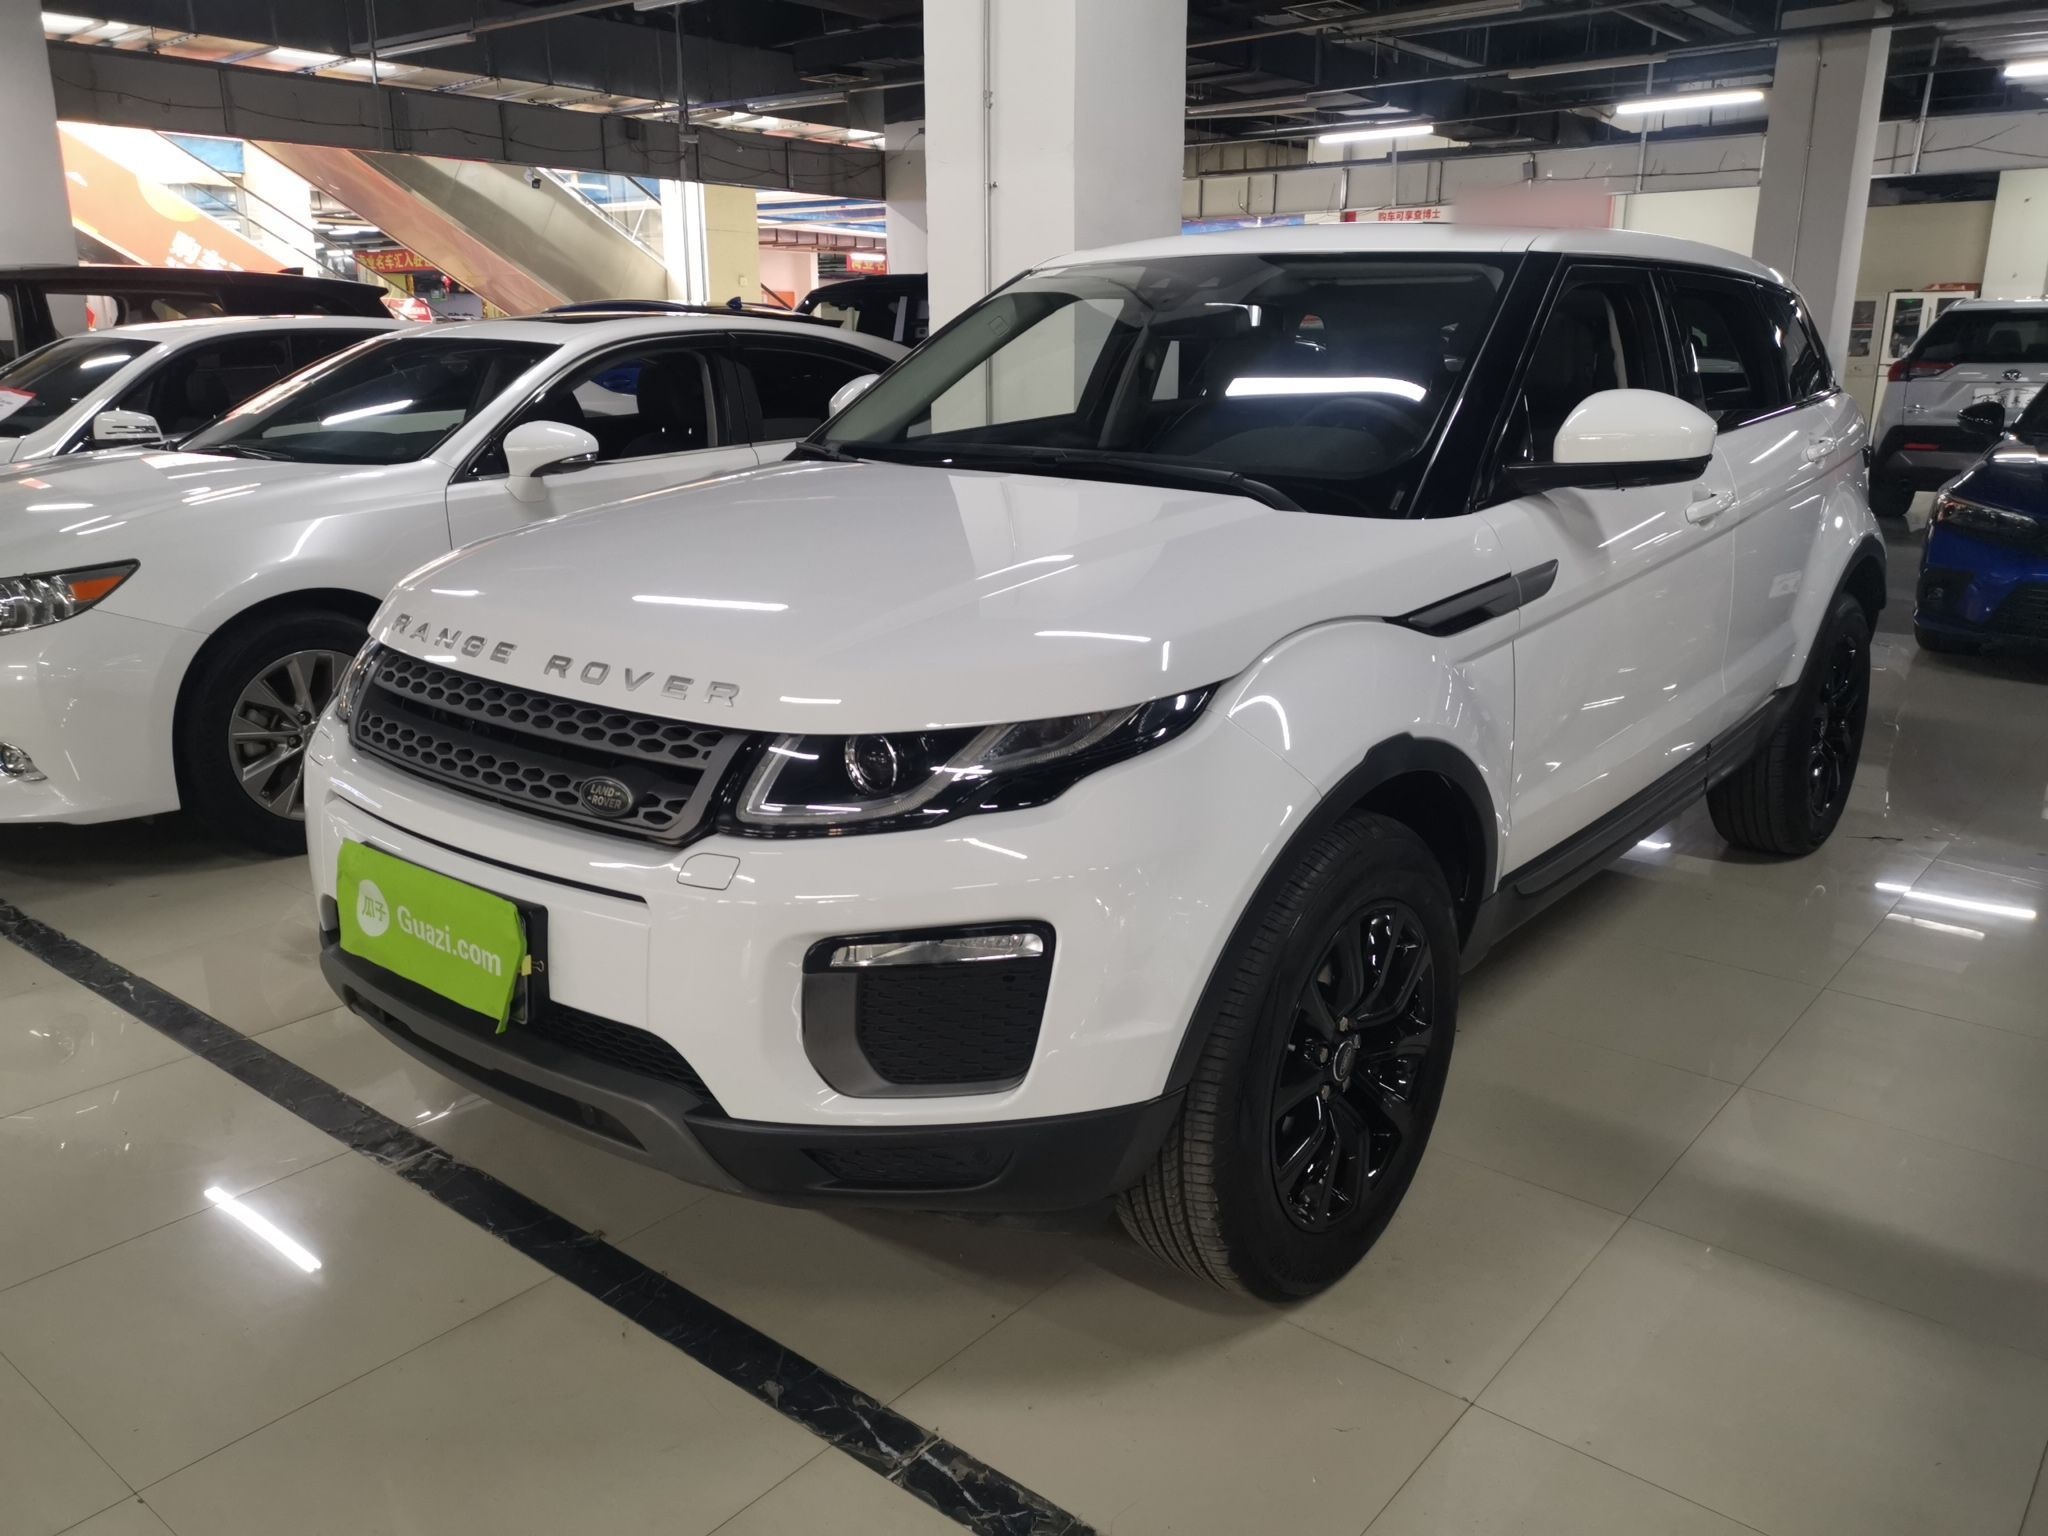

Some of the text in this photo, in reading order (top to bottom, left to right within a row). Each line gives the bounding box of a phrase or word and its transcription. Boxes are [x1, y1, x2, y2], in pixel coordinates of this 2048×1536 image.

[391, 613, 740, 707] RANGE ROVER
[590, 784, 615, 797] LAND
[592, 795, 622, 809] ROVER
[361, 896, 387, 922] 瓜子
[396, 905, 502, 977] Guazi.com
